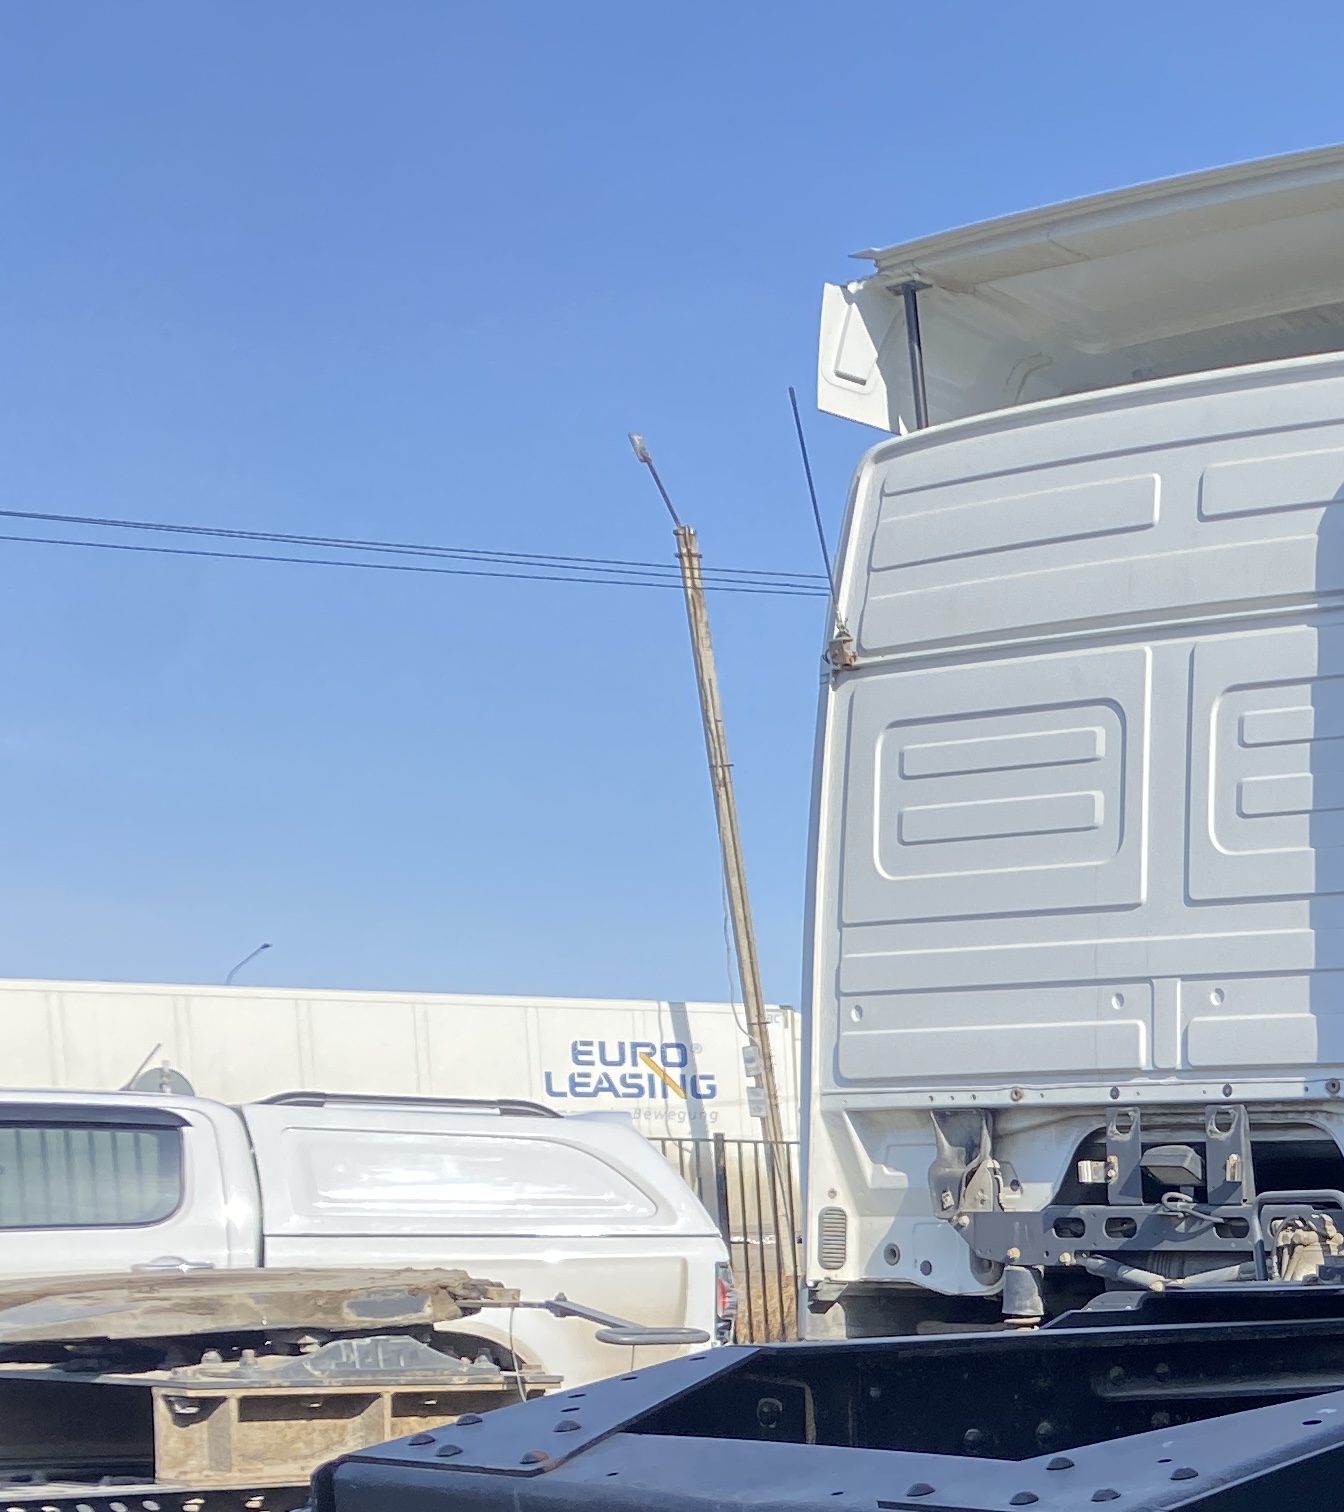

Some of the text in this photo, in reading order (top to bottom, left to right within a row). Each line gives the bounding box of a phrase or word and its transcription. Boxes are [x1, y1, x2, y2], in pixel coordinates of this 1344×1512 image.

[571, 1041, 688, 1068] EURO
[545, 1072, 717, 1099] LEASING
[633, 1107, 719, 1123] Bewegung
